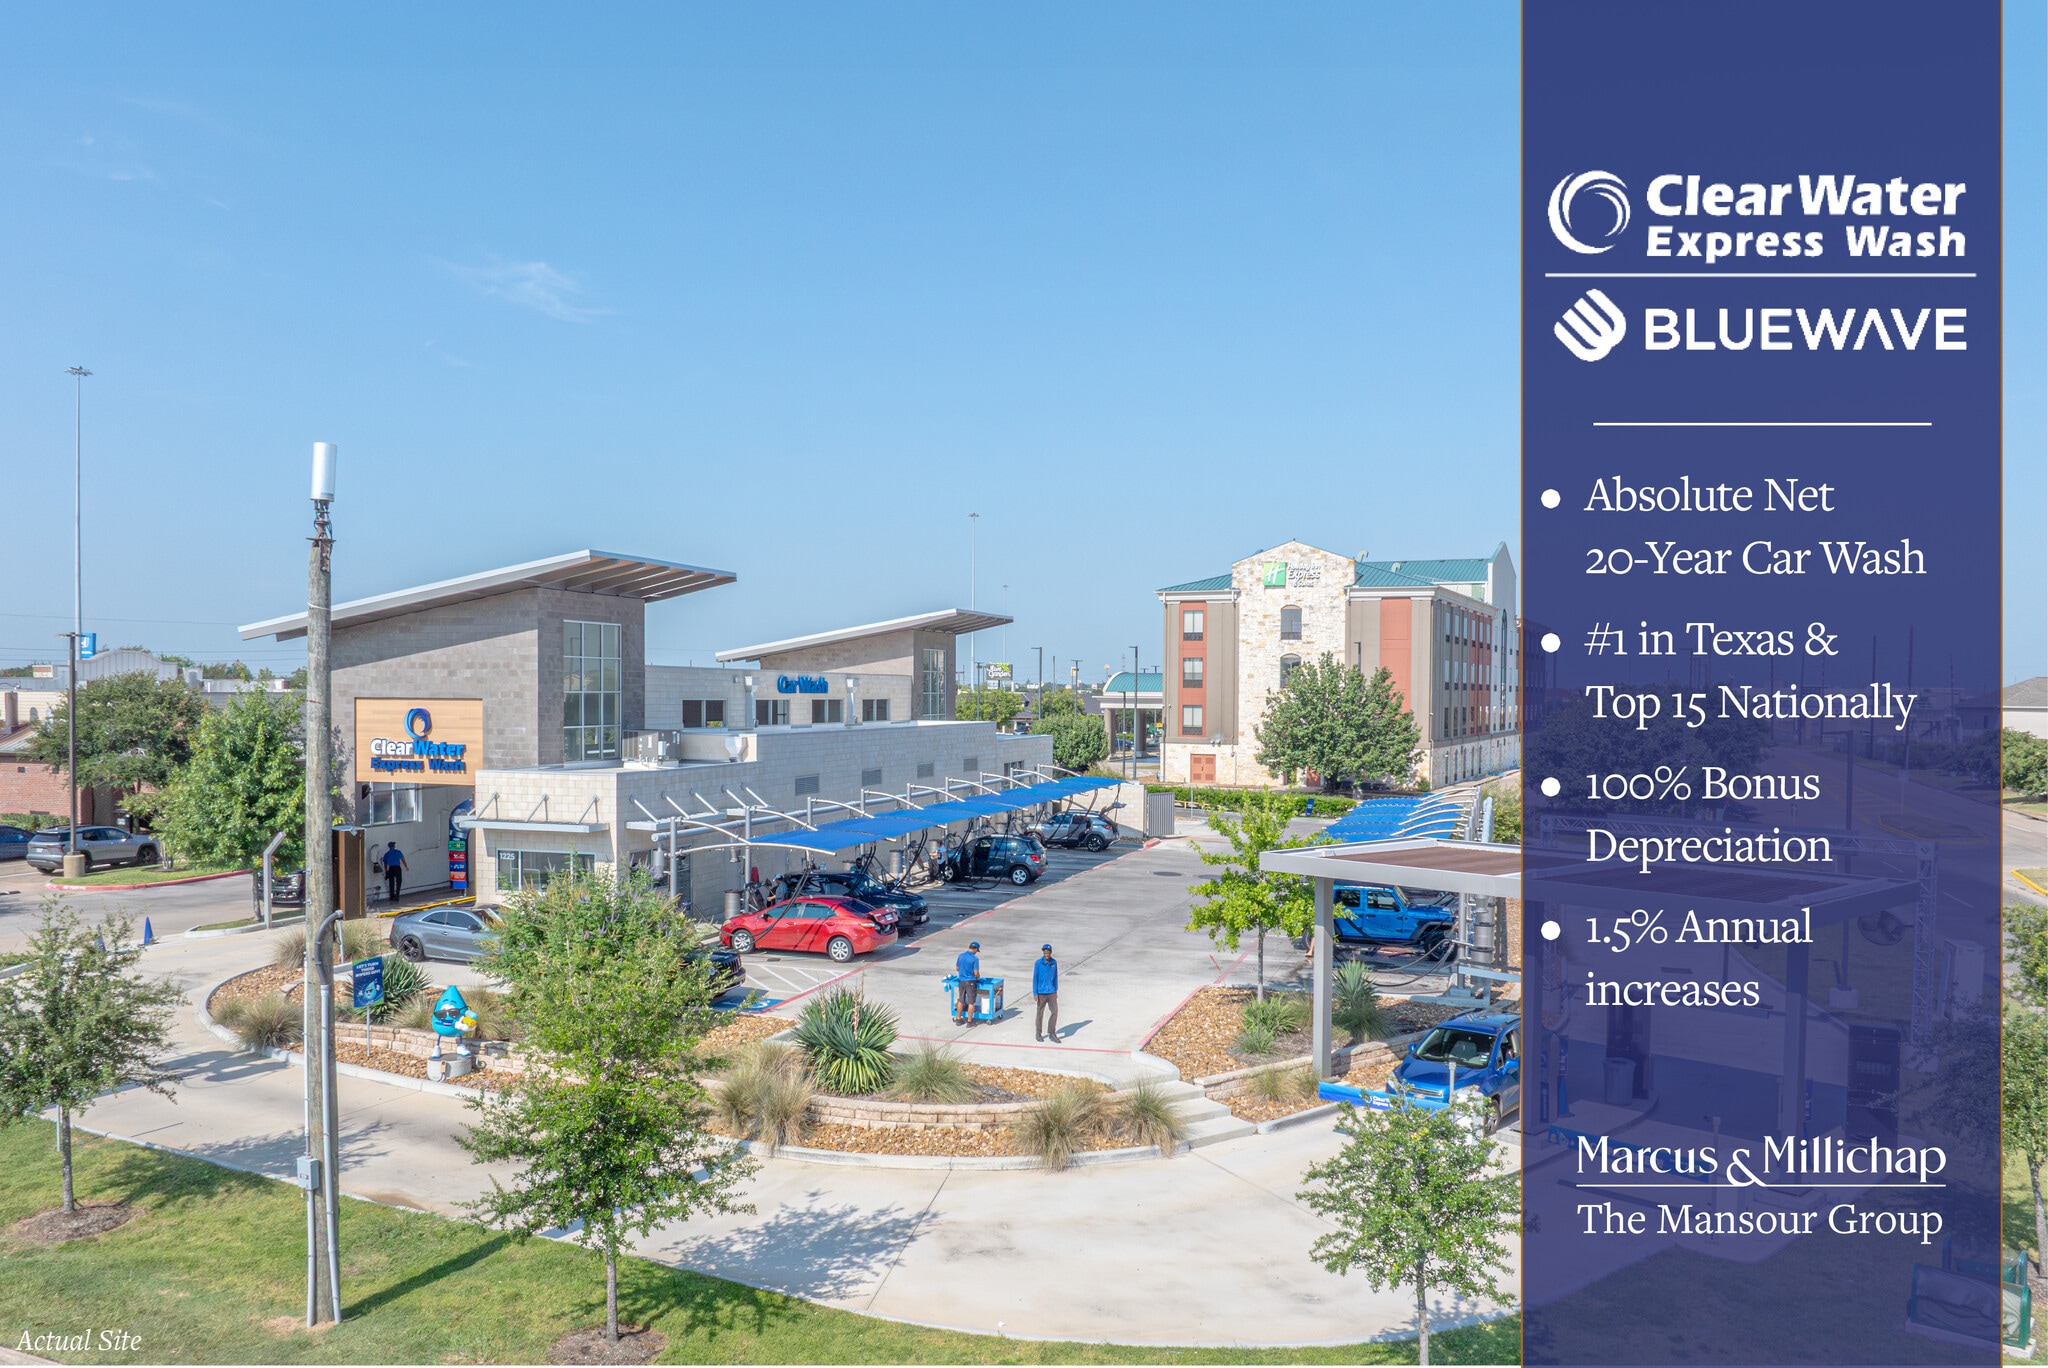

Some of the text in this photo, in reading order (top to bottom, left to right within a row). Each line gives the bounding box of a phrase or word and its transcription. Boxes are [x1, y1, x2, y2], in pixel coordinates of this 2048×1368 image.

[777, 675, 829, 694] Car Wash
[370, 757, 466, 773] Express Wash
